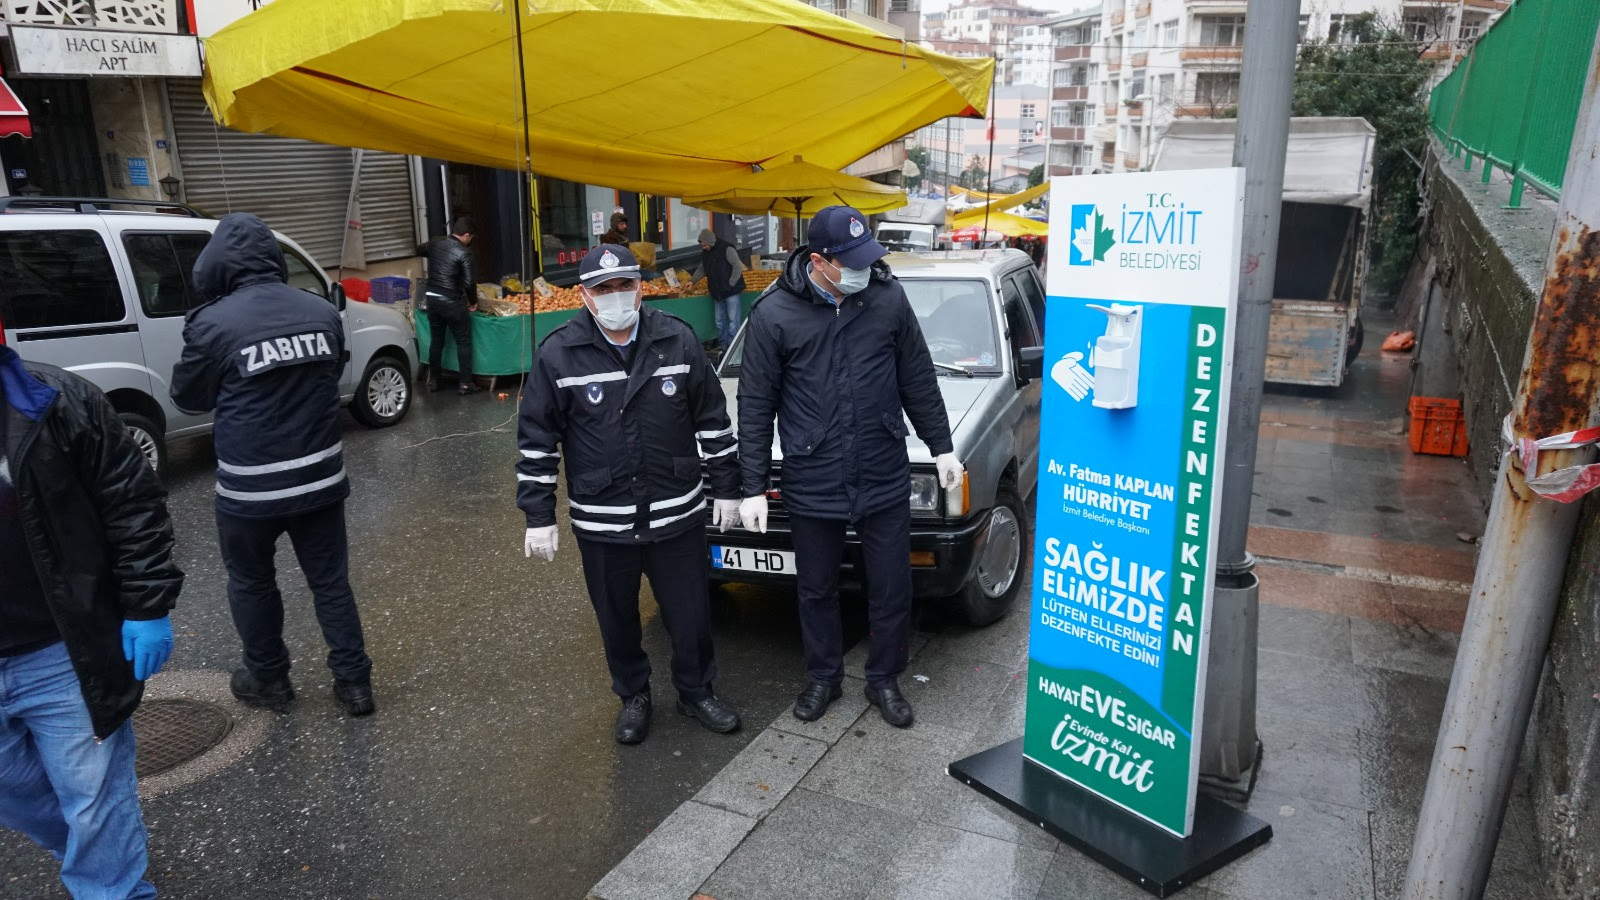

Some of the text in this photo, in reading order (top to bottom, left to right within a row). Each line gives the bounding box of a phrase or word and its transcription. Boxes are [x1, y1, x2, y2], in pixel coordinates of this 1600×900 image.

[66, 37, 157, 54] HACI SALİM
[99, 56, 128, 70] APT
[1146, 193, 1175, 208] T.C.
[1121, 202, 1203, 244] İZMİT
[1120, 250, 1201, 270] BELEDİYESİ
[240, 333, 332, 372] ZABITA
[1048, 459, 1174, 501] Av. Fatma KAPLAN
[1173, 323, 1216, 656] DEZENFEKTAN
[1063, 483, 1151, 520] HÜRRİYET
[1063, 502, 1150, 535] İzmit Belediye Başkanı
[723, 549, 784, 571] 41 HD
[1044, 537, 1166, 602] SAĞLIK
[1041, 613, 1159, 668] DEZENFEKTE EDİN!
[1042, 598, 1161, 651] LÜTFEN ELLERİNİZİ
[1039, 677, 1175, 749] HAYAT EVE SIĞAR
[1069, 720, 1132, 755] Evinde Kal
